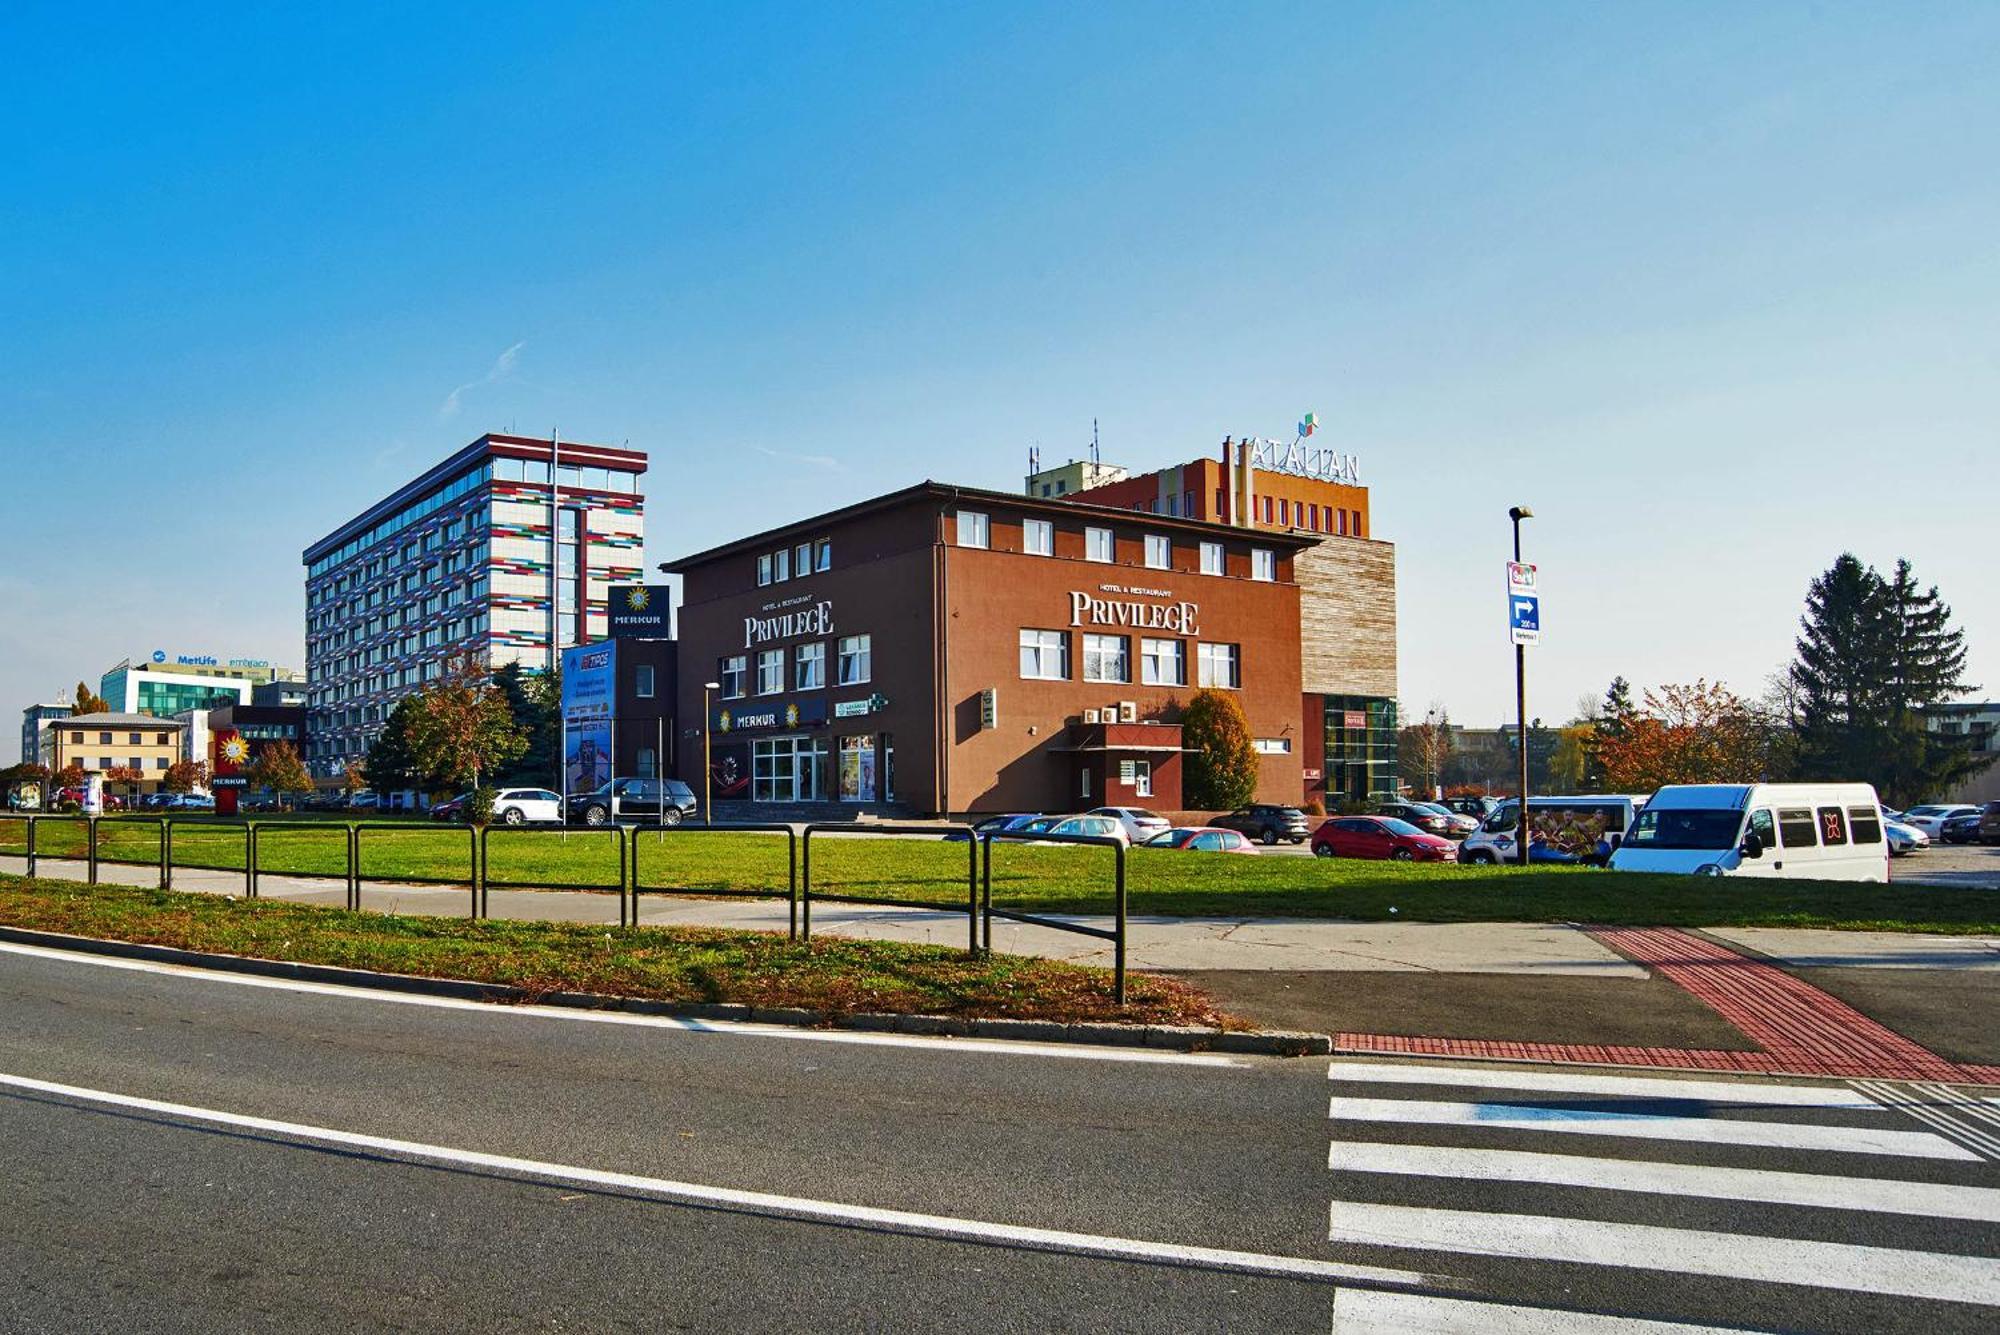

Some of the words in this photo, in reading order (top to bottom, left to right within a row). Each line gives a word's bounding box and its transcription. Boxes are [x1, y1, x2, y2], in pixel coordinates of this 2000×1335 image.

[1252, 437, 1360, 480] ATALIAN
[1100, 584, 1121, 593] HOTEL
[1130, 586, 1172, 598] RESTAURANT
[614, 616, 661, 624] MERKUR
[1069, 590, 1200, 637] PRIVILEGE
[743, 600, 834, 649] PRIVILEGE
[177, 655, 218, 667] MetLife
[736, 714, 776, 728] MERKUR
